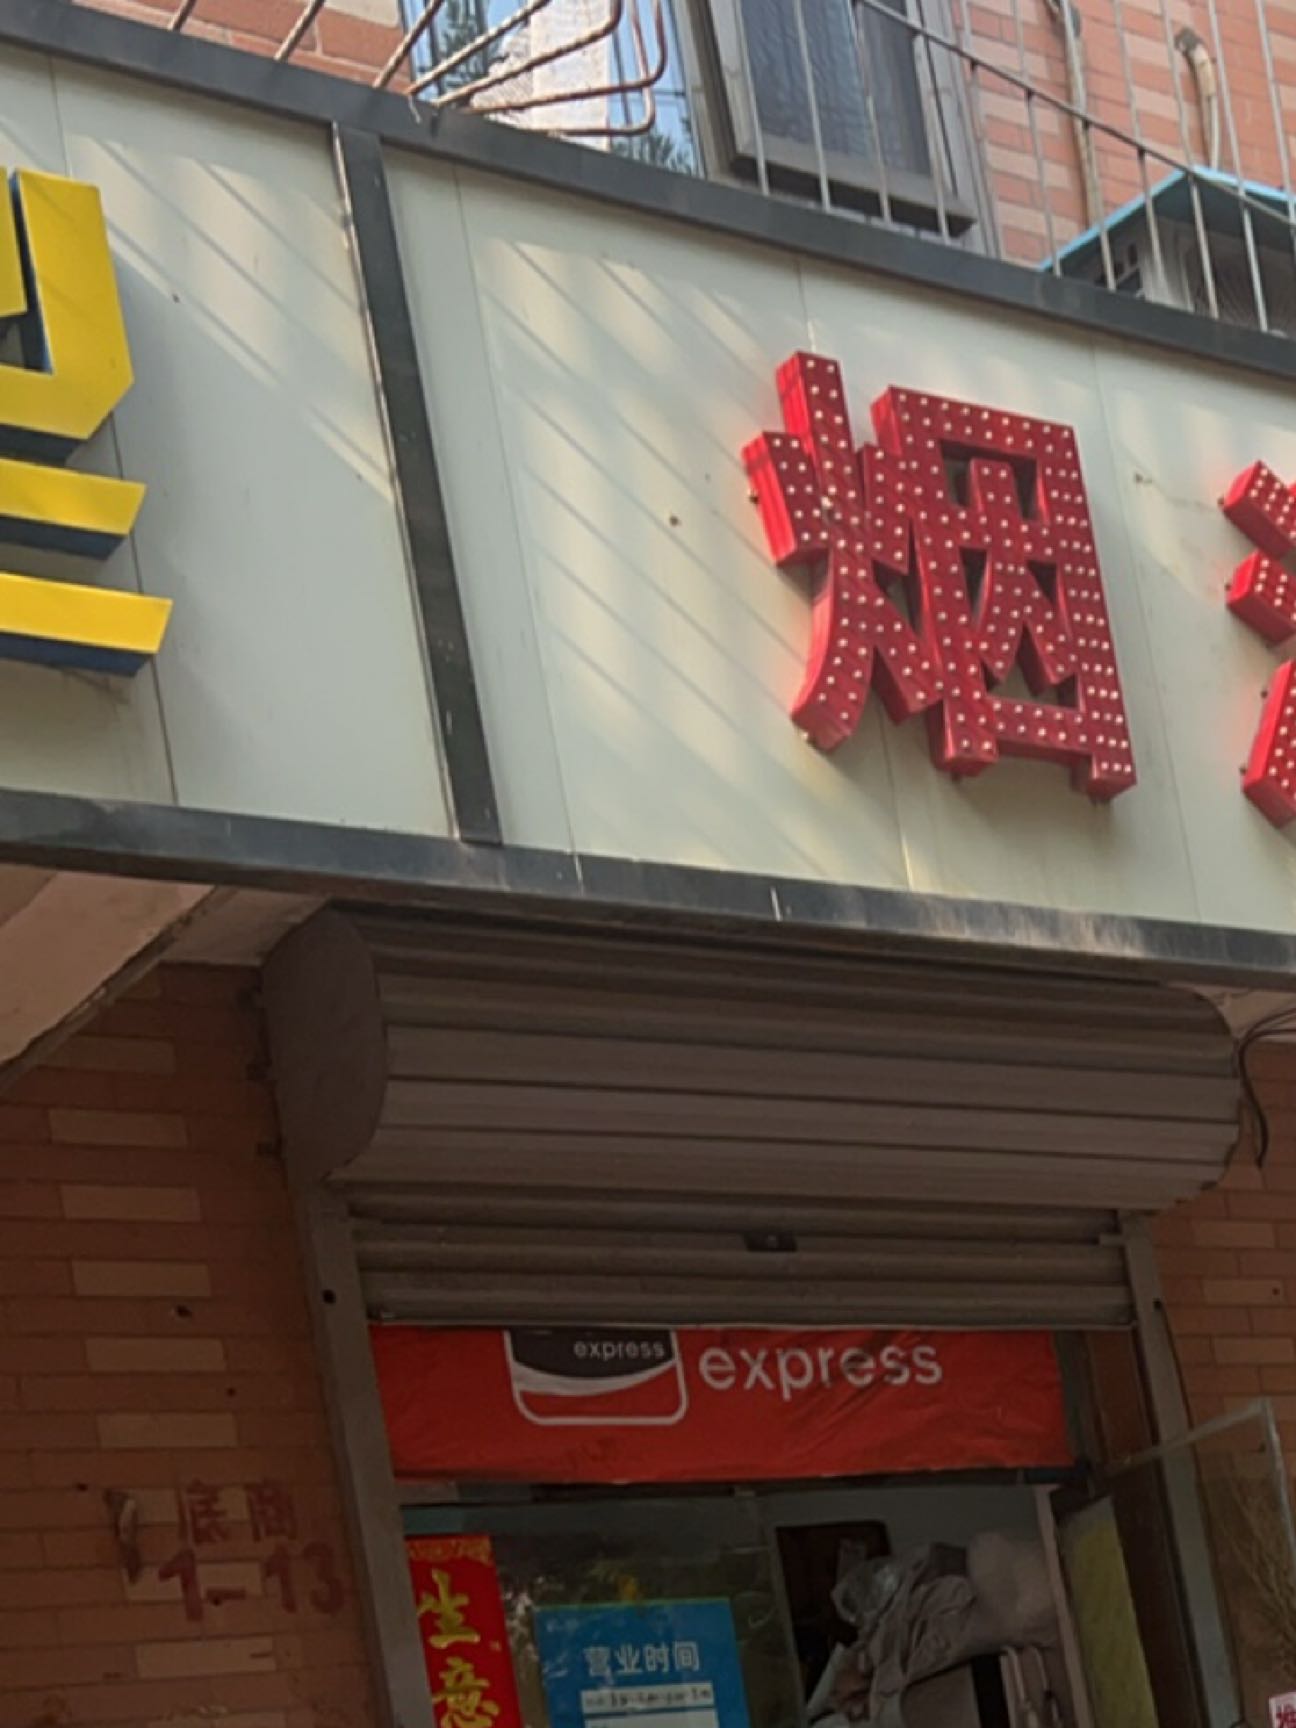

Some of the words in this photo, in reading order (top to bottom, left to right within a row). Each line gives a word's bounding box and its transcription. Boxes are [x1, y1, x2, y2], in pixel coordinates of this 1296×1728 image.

[574, 1339, 665, 1360] express
[700, 1345, 943, 1401] express
[583, 1641, 699, 1677] 营业时间
